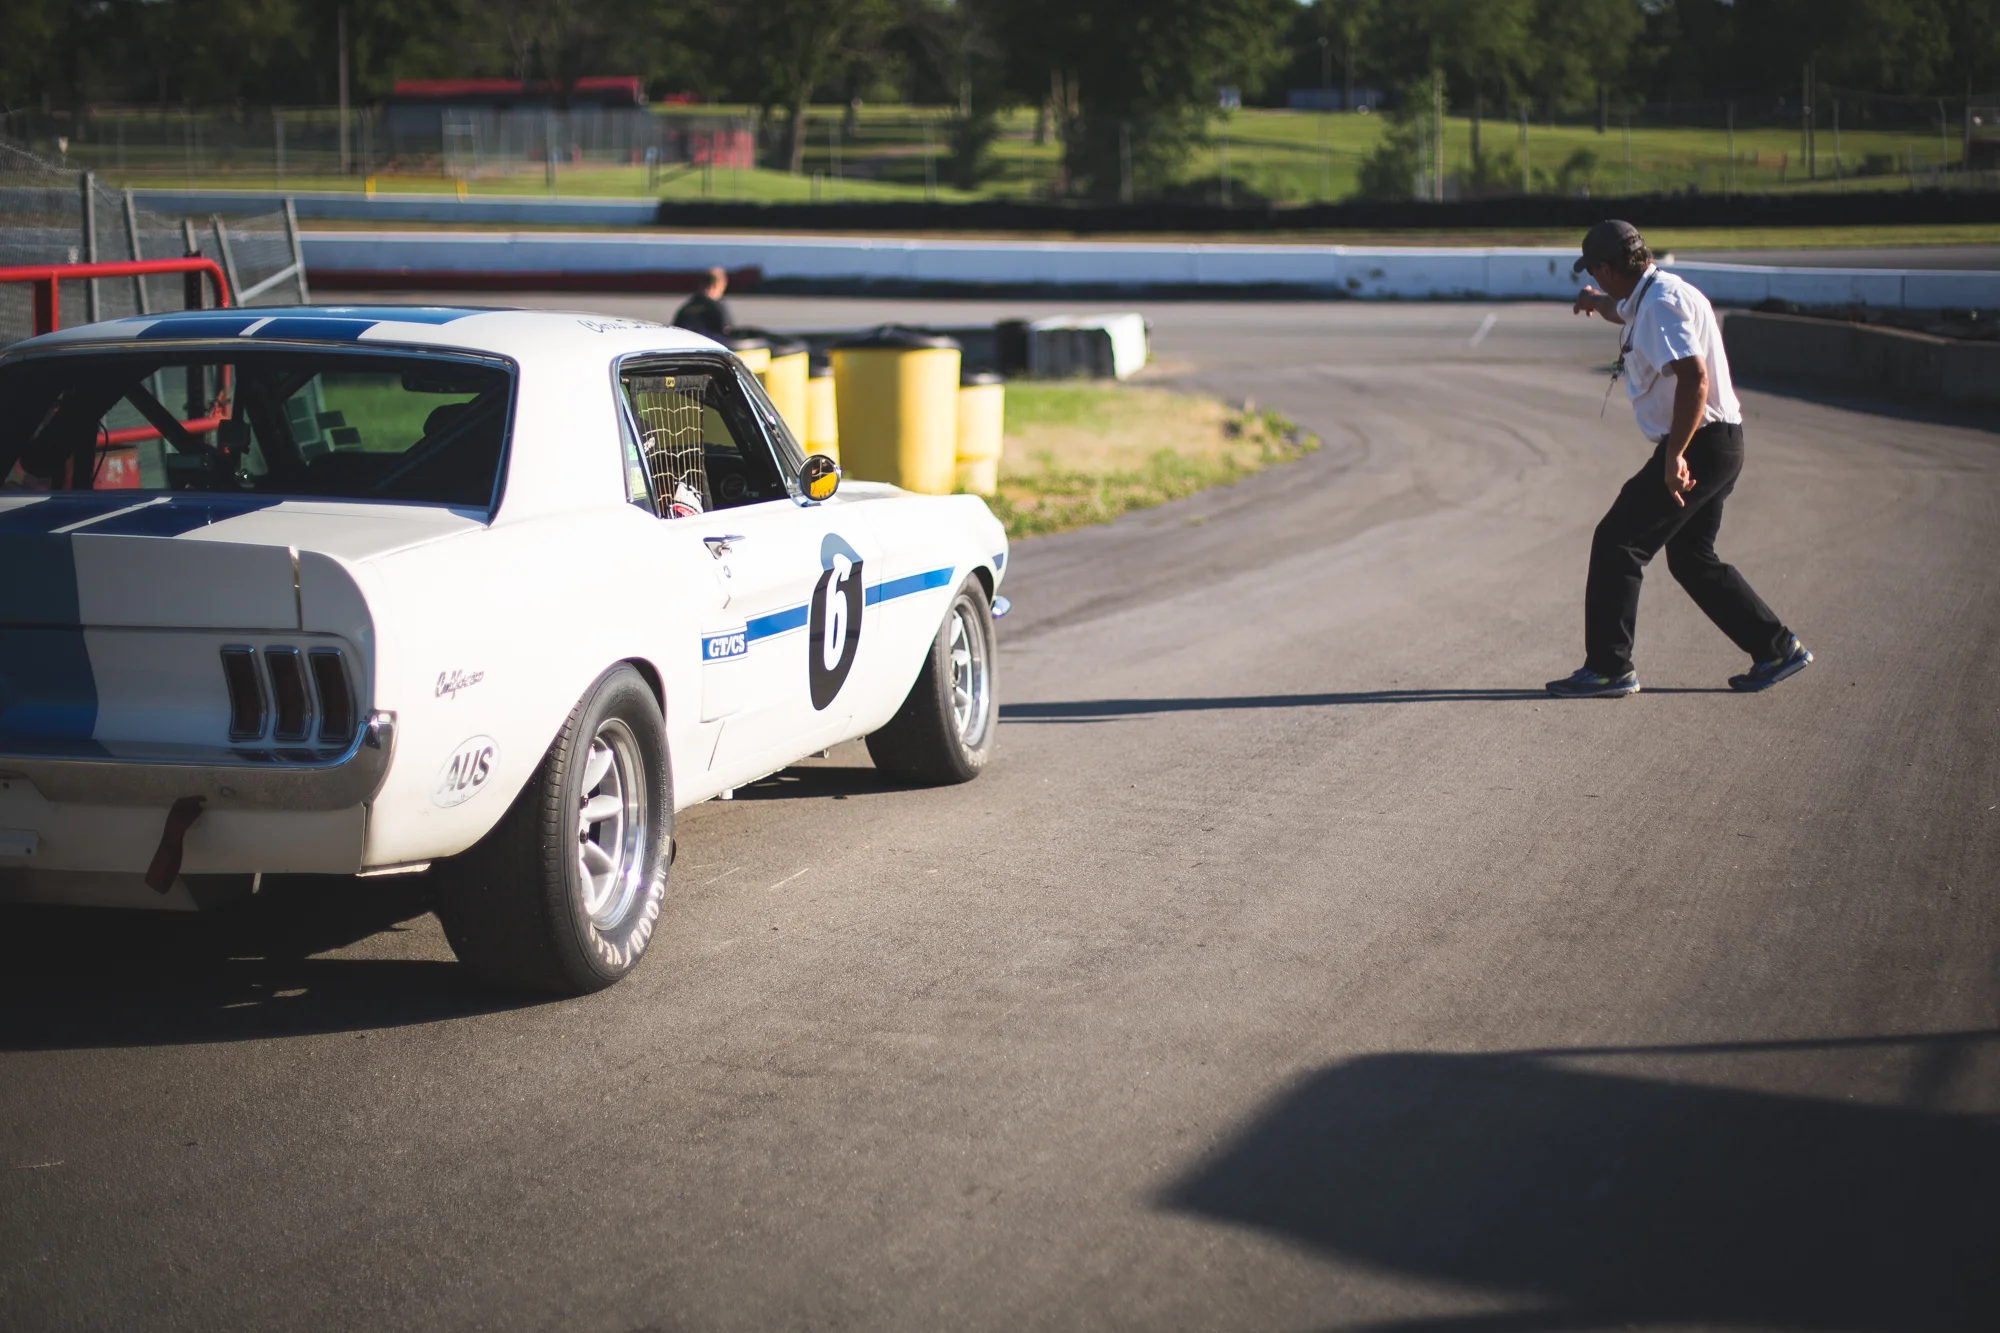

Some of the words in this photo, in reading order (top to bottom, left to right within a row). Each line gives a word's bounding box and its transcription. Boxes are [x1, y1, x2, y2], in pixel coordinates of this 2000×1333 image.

[823, 553, 853, 671] 6
[709, 633, 745, 657] GT/CS
[436, 745, 494, 794] AUS
